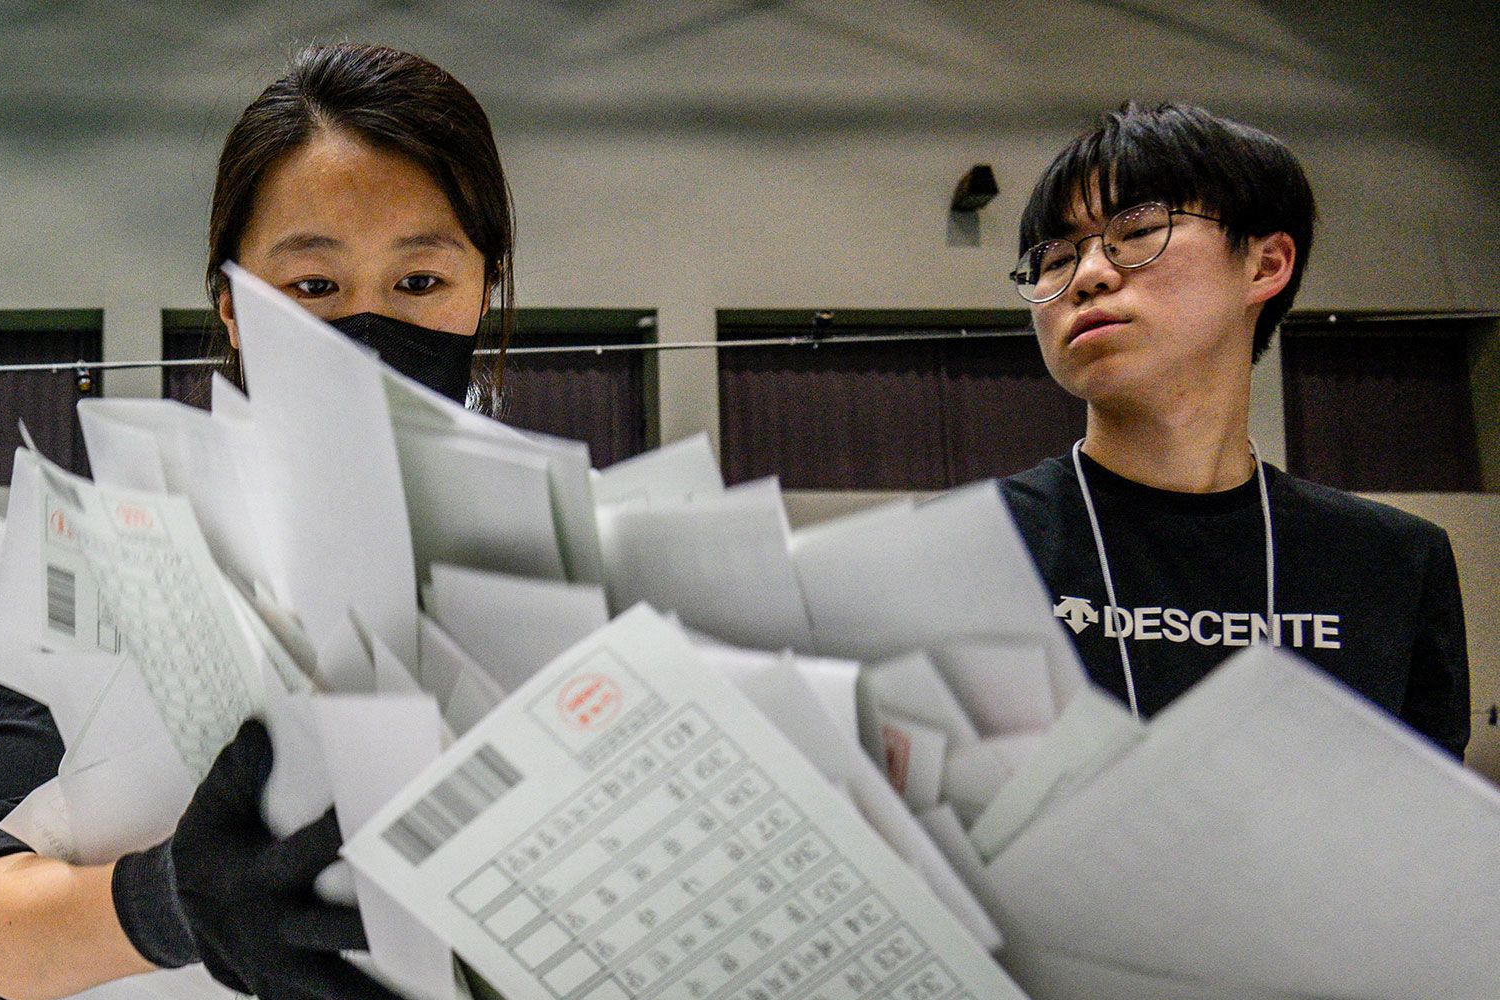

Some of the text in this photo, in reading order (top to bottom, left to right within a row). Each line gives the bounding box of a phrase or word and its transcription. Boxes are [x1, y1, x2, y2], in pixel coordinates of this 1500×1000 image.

[1104, 605, 1341, 649] DESCENTE
[690, 745, 731, 783] 39
[720, 777, 760, 813] 38
[752, 807, 791, 845] 37
[779, 837, 821, 876] 36
[810, 869, 852, 907] 35
[841, 902, 882, 940] 34
[870, 935, 914, 980] 33
